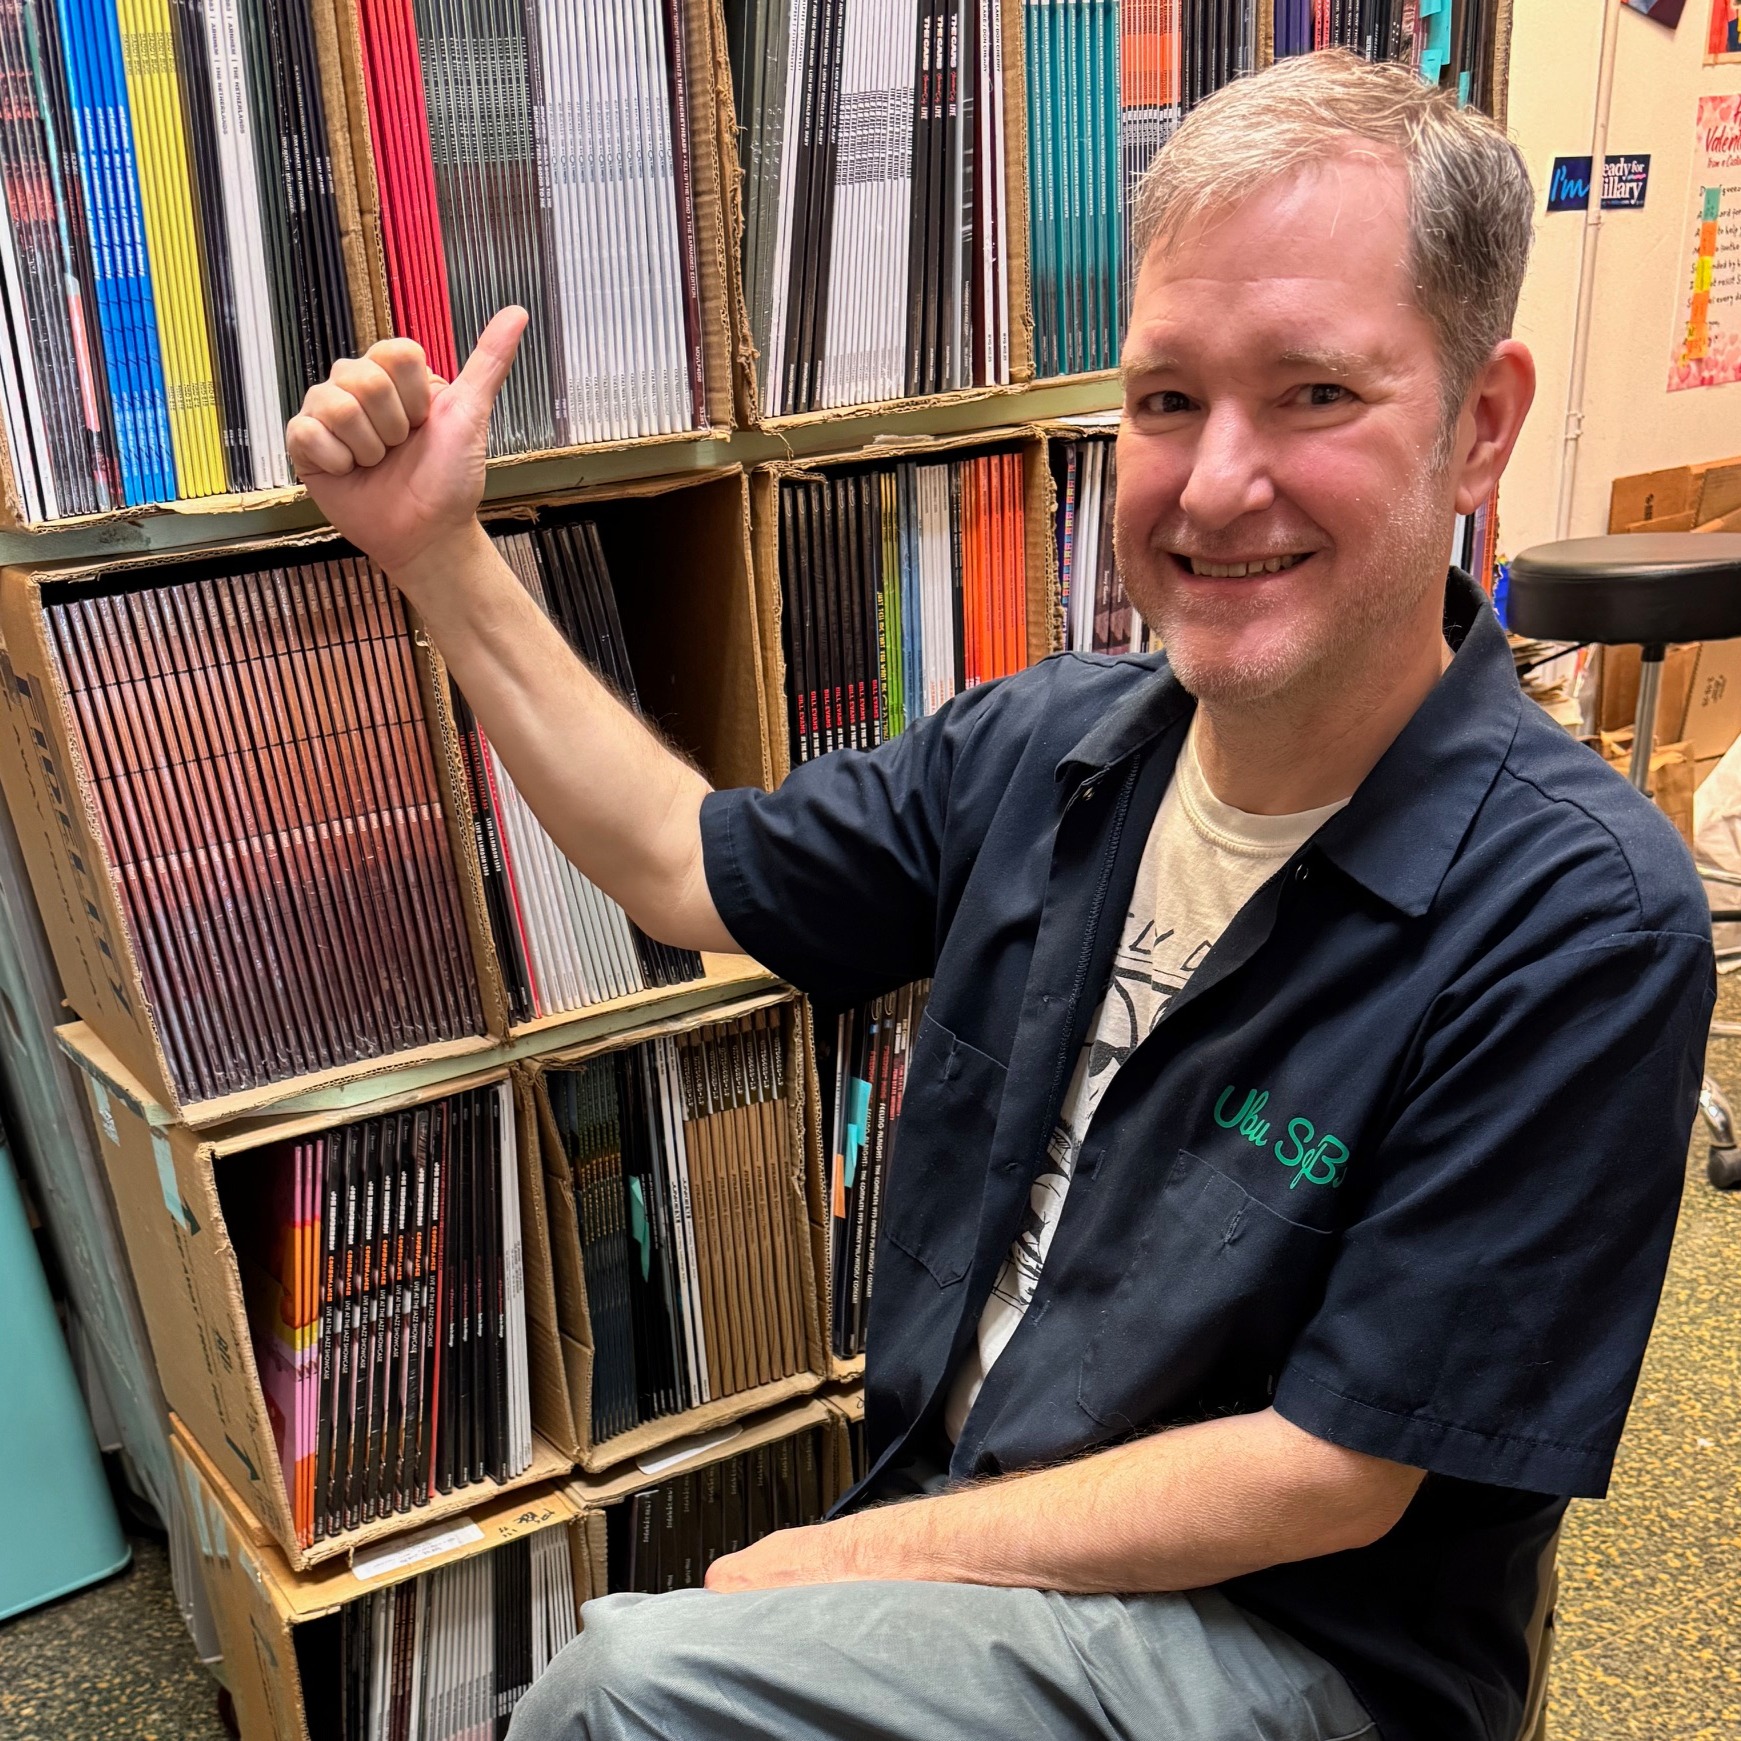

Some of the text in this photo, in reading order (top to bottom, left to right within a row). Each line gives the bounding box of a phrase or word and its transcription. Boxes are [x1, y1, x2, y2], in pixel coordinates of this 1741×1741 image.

[807, 83, 813, 92] MY
[1551, 165, 1590, 202] I'm
[1602, 158, 1646, 180] eady for
[1601, 176, 1643, 205] illary
[131, 207, 138, 216] of
[135, 244, 146, 276] debussy
[877, 1103, 886, 1129] FEELING
[1214, 1085, 1270, 1146] Ubu
[398, 1187, 406, 1229] HENDERSON
[872, 1177, 880, 1205] COMPLETE
[365, 1197, 373, 1240] HENDERSON
[363, 1245, 371, 1290] CONSONANCE
[396, 1235, 404, 1280] CONSONANCE
